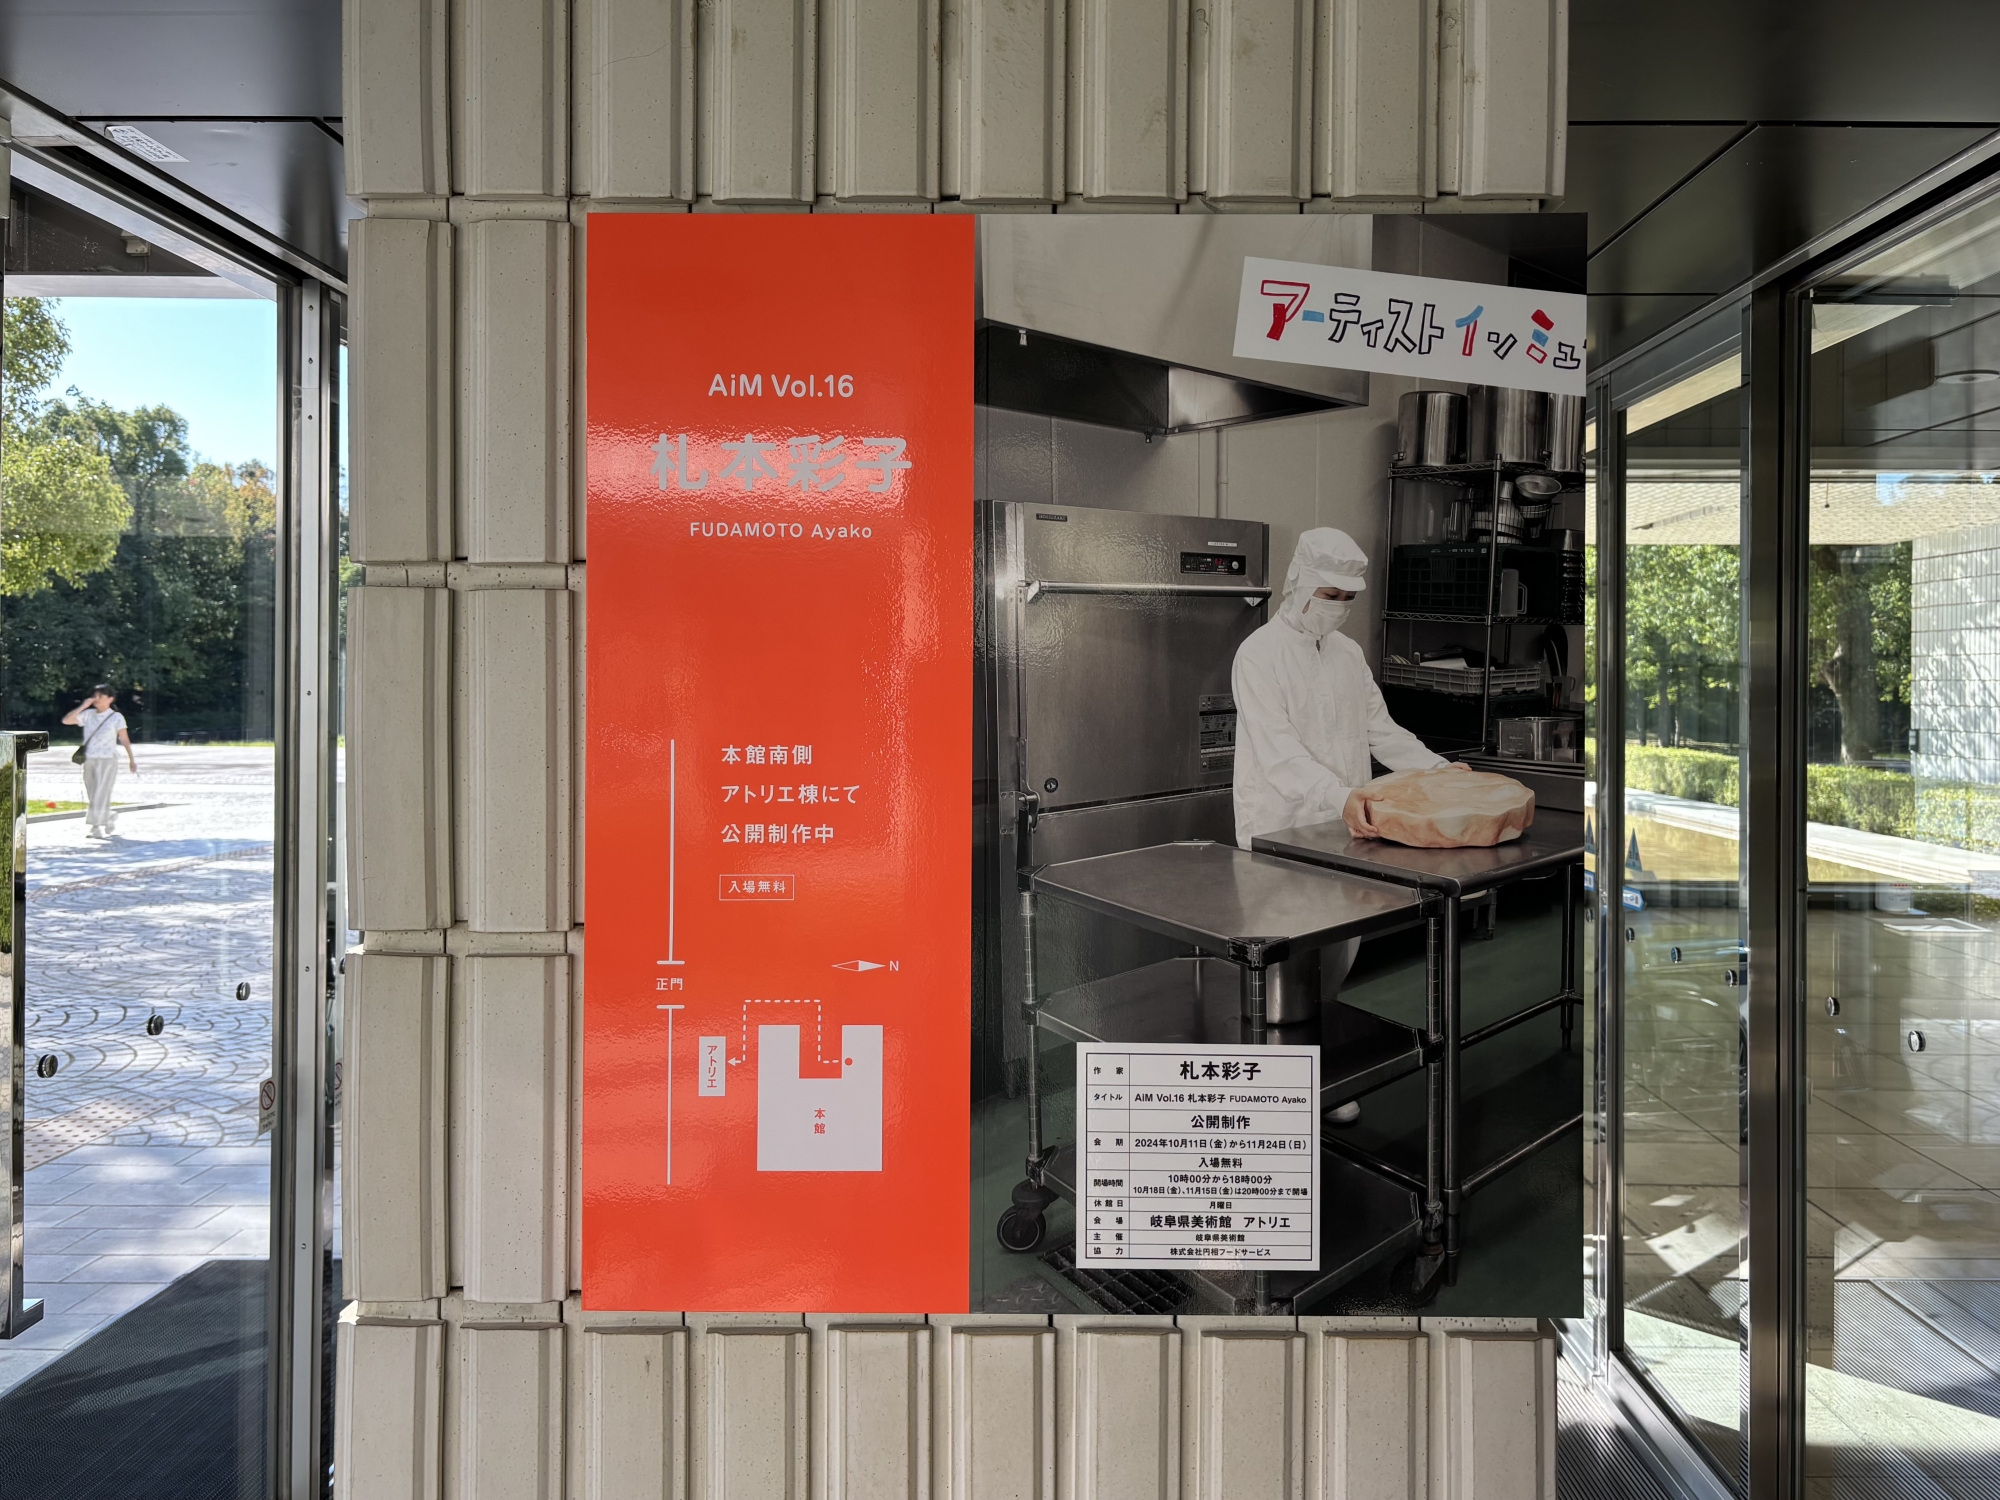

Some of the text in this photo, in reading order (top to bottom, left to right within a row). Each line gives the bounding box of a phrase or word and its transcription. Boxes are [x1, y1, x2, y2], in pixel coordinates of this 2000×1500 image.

[708, 374, 854, 398] AiM Vol.16
[649, 433, 912, 492] 札本彩子
[690, 521, 872, 540] FUDAMOTO Ayako
[721, 745, 812, 765] 本館南側
[721, 784, 860, 804] アトリエ棟にて
[721, 823, 834, 844] 公開制作中
[728, 880, 786, 894] 入場無料
[889, 960, 900, 972] N
[656, 977, 684, 991] 正門
[706, 1045, 718, 1089] アトリエ
[1180, 1061, 1261, 1080] 札本彩子
[1093, 1093, 1123, 1101] タイトル
[1135, 1093, 1307, 1105] AiM Vol.16 札本彩子 FUDAMOTO Ayako
[814, 1107, 826, 1135] 本館
[1190, 1115, 1251, 1129] 公開制作
[1198, 1157, 1243, 1169] 入場無料
[1168, 1174, 1273, 1184] 10時00分から18時00分
[1209, 1201, 1232, 1210] 月曜日
[1150, 1215, 1291, 1229] 岐阜県美術館 アトリエ
[1195, 1233, 1246, 1243] 岐阜県美術館
[1169, 1247, 1271, 1257] 株式会社円相フードサービス
